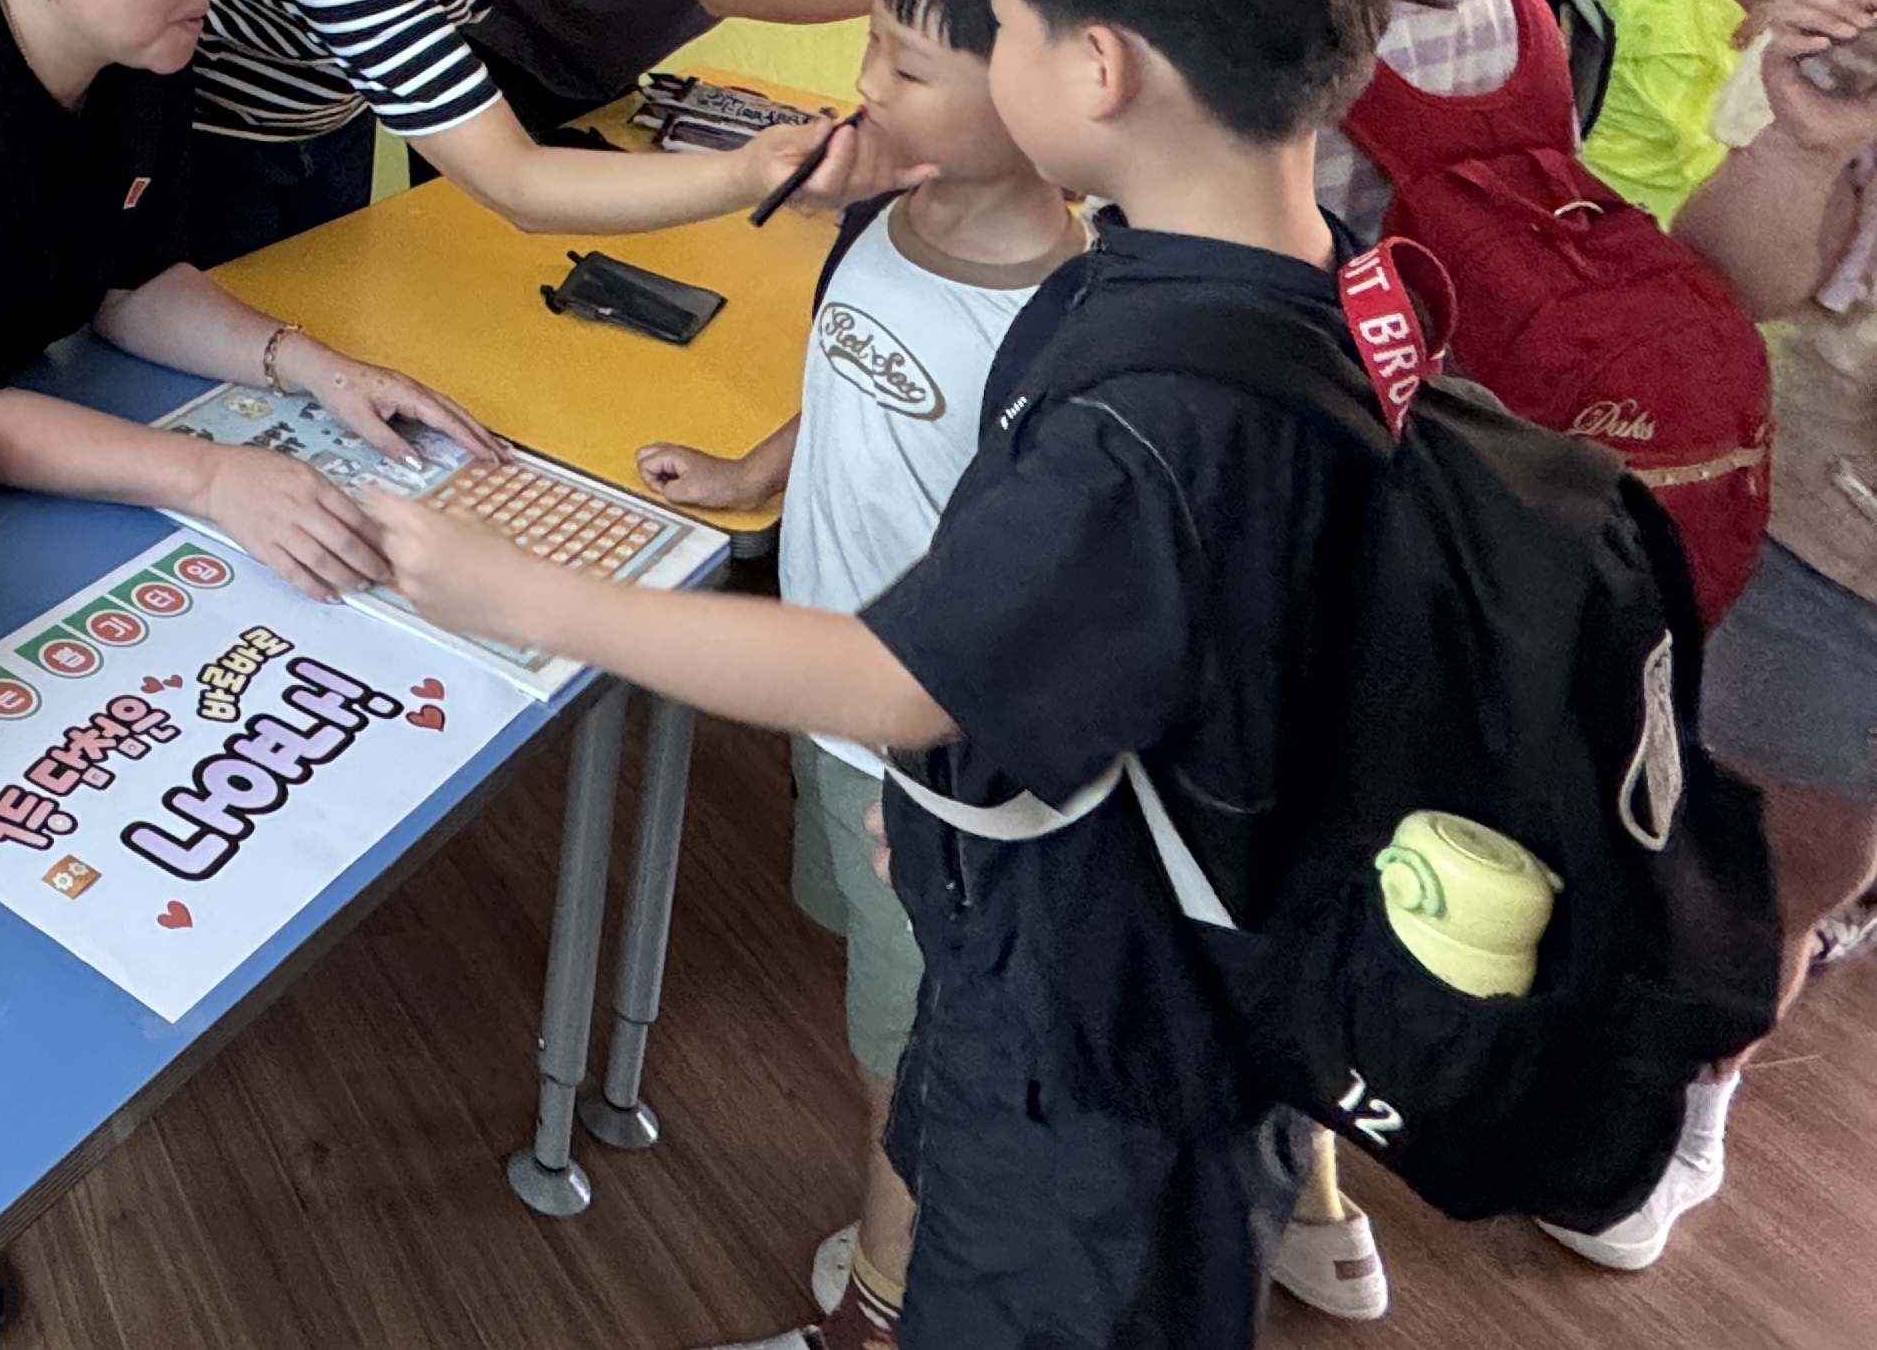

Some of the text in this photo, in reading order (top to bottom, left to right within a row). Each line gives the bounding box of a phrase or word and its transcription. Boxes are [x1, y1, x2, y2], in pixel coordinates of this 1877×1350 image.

[825, 308, 927, 404] Red Sox
[196, 625, 296, 724] 바로바로
[1338, 1068, 1405, 1148] 12
